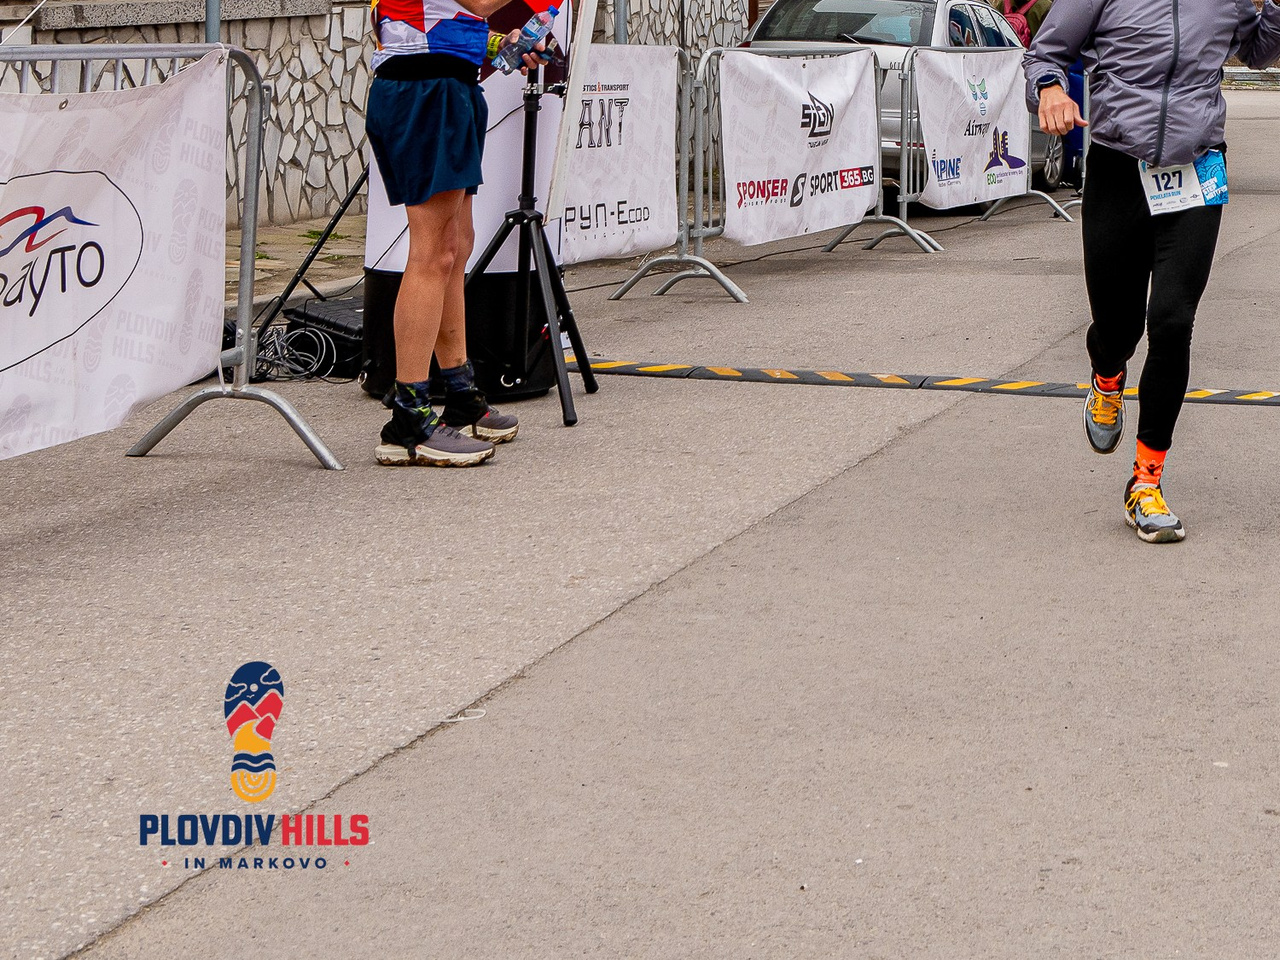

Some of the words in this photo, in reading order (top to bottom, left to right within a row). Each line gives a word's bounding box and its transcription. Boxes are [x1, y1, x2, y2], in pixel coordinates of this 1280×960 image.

[736, 178, 789, 209] SPONSER
[810, 171, 839, 196] SPORT
[840, 167, 874, 189] 365.BG
[1151, 170, 1183, 192] 127
